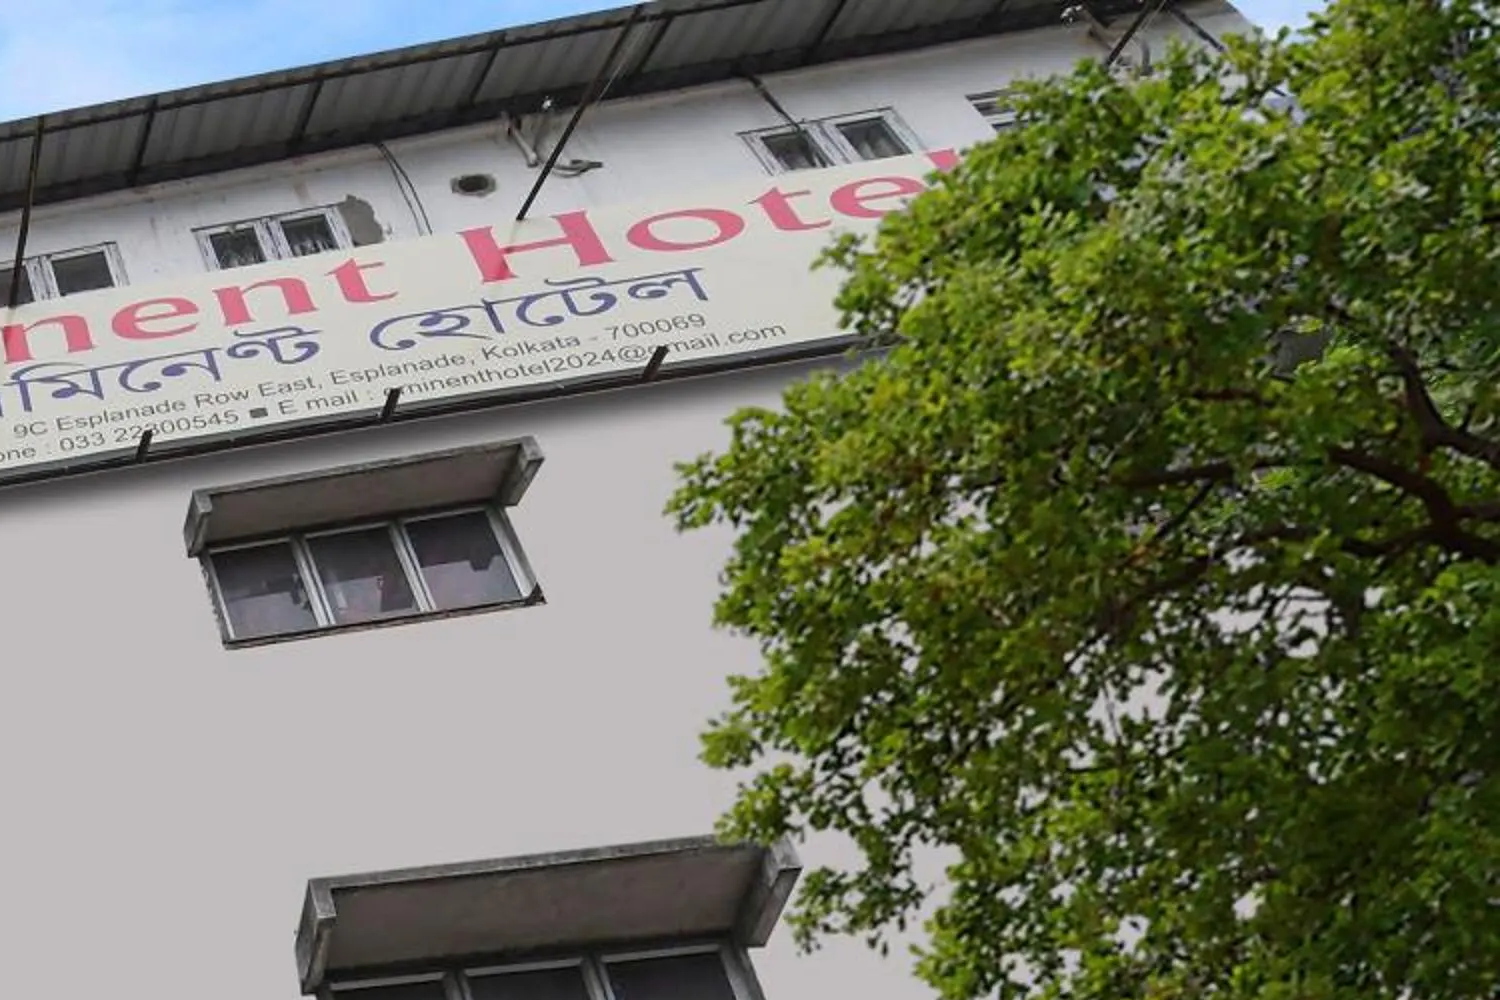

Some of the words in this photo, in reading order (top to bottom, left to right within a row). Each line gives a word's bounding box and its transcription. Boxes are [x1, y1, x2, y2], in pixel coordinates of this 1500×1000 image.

[457, 146, 960, 284] Hote
[369, 267, 709, 348] হোটেল
[12, 419, 49, 439] 9C
[56, 400, 187, 431] Esplanade
[194, 388, 250, 409] Row
[258, 373, 324, 397] East,
[331, 352, 476, 385] Esplanade,
[481, 334, 581, 360] Kolkata
[605, 313, 707, 341] 700069
[59, 431, 106, 452] 033
[278, 400, 298, 416] E
[306, 389, 359, 411] mail
